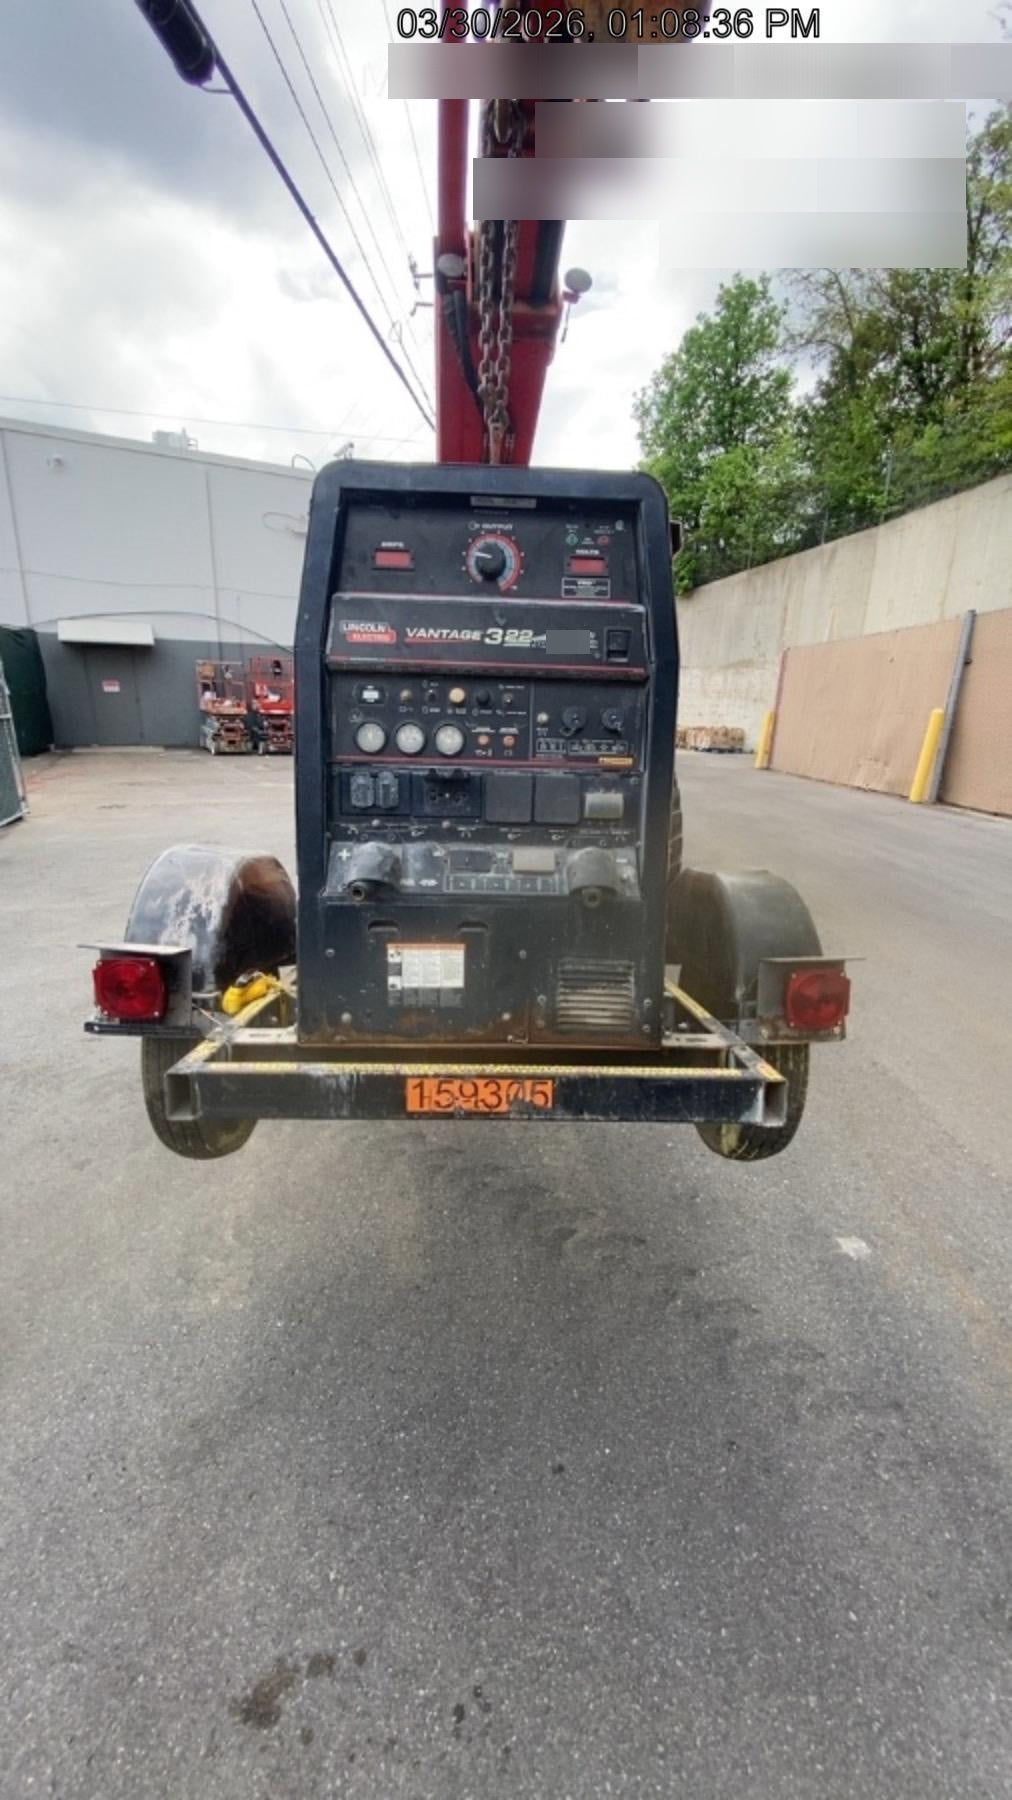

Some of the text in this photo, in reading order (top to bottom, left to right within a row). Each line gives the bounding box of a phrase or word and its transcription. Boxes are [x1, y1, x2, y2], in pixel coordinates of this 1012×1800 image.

[343, 623, 386, 632] LINCOLN
[405, 627, 481, 641] VANTAGE
[484, 627, 534, 645] 322
